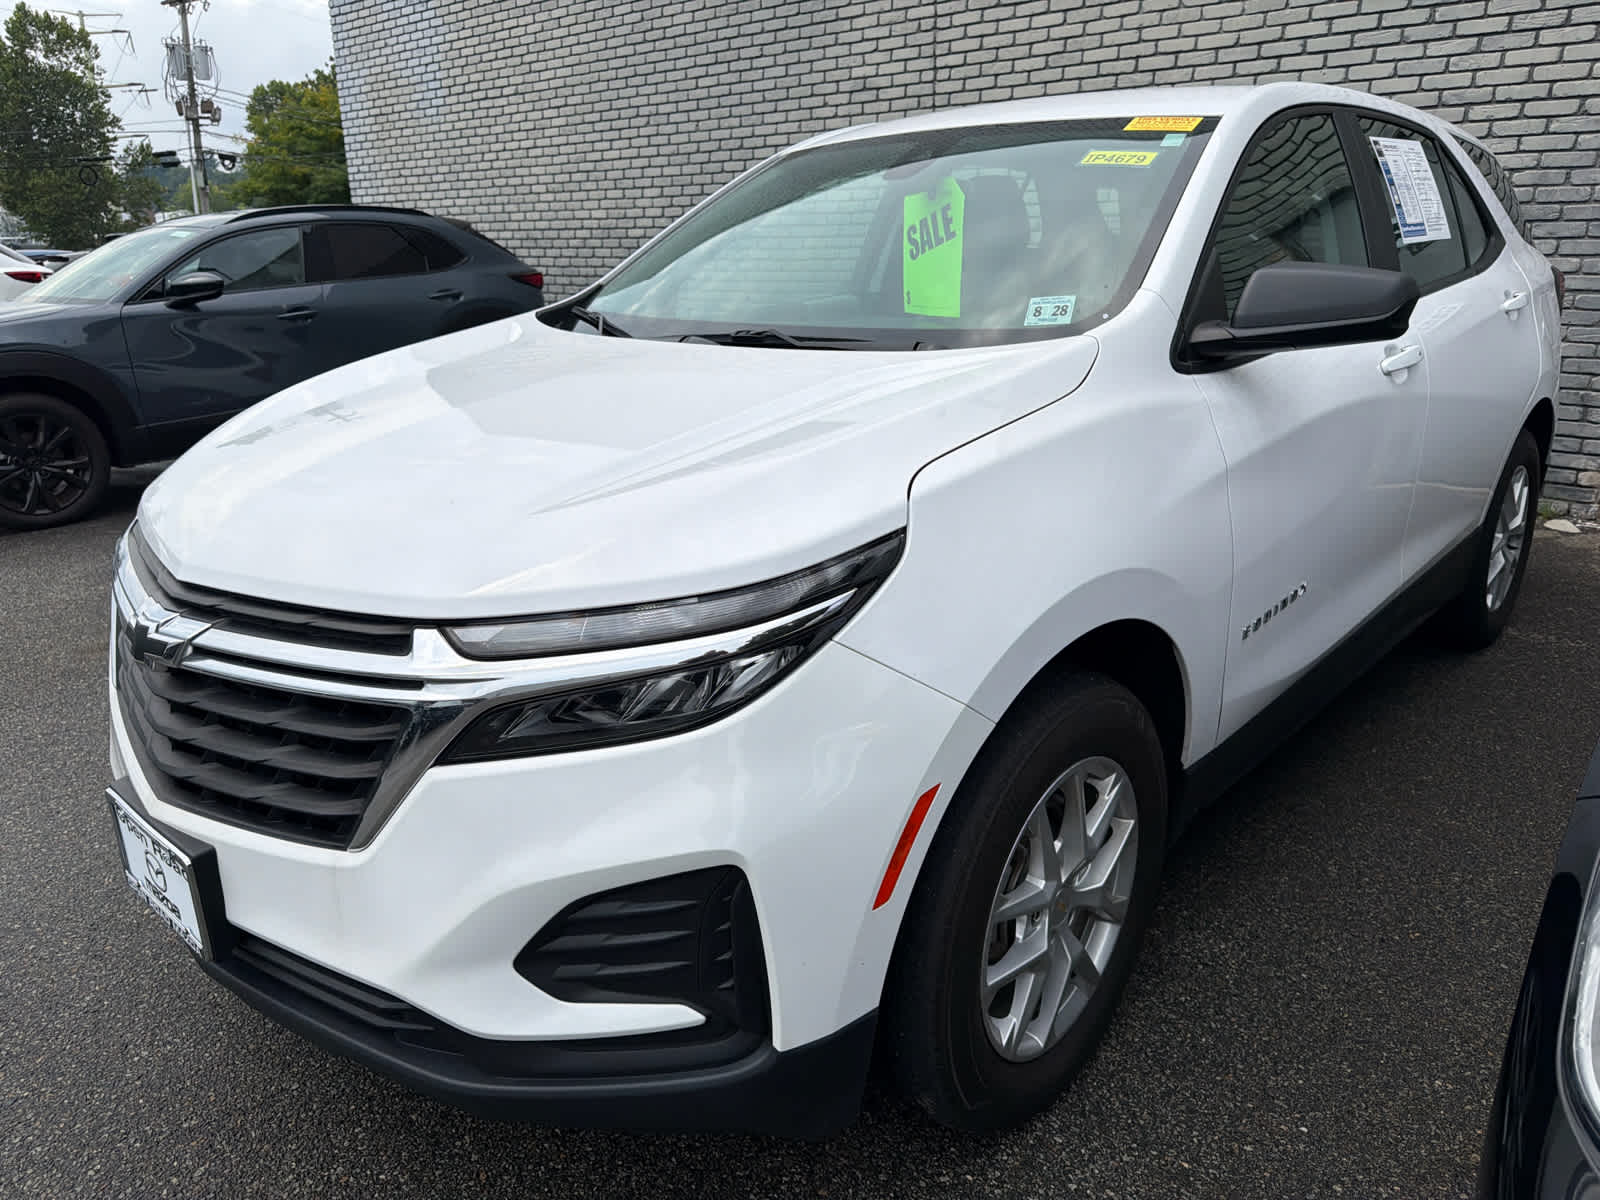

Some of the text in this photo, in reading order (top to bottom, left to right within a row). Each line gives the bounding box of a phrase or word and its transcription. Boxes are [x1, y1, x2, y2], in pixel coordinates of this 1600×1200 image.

[906, 203, 958, 261] SALE
[1033, 304, 1069, 318] 8 28
